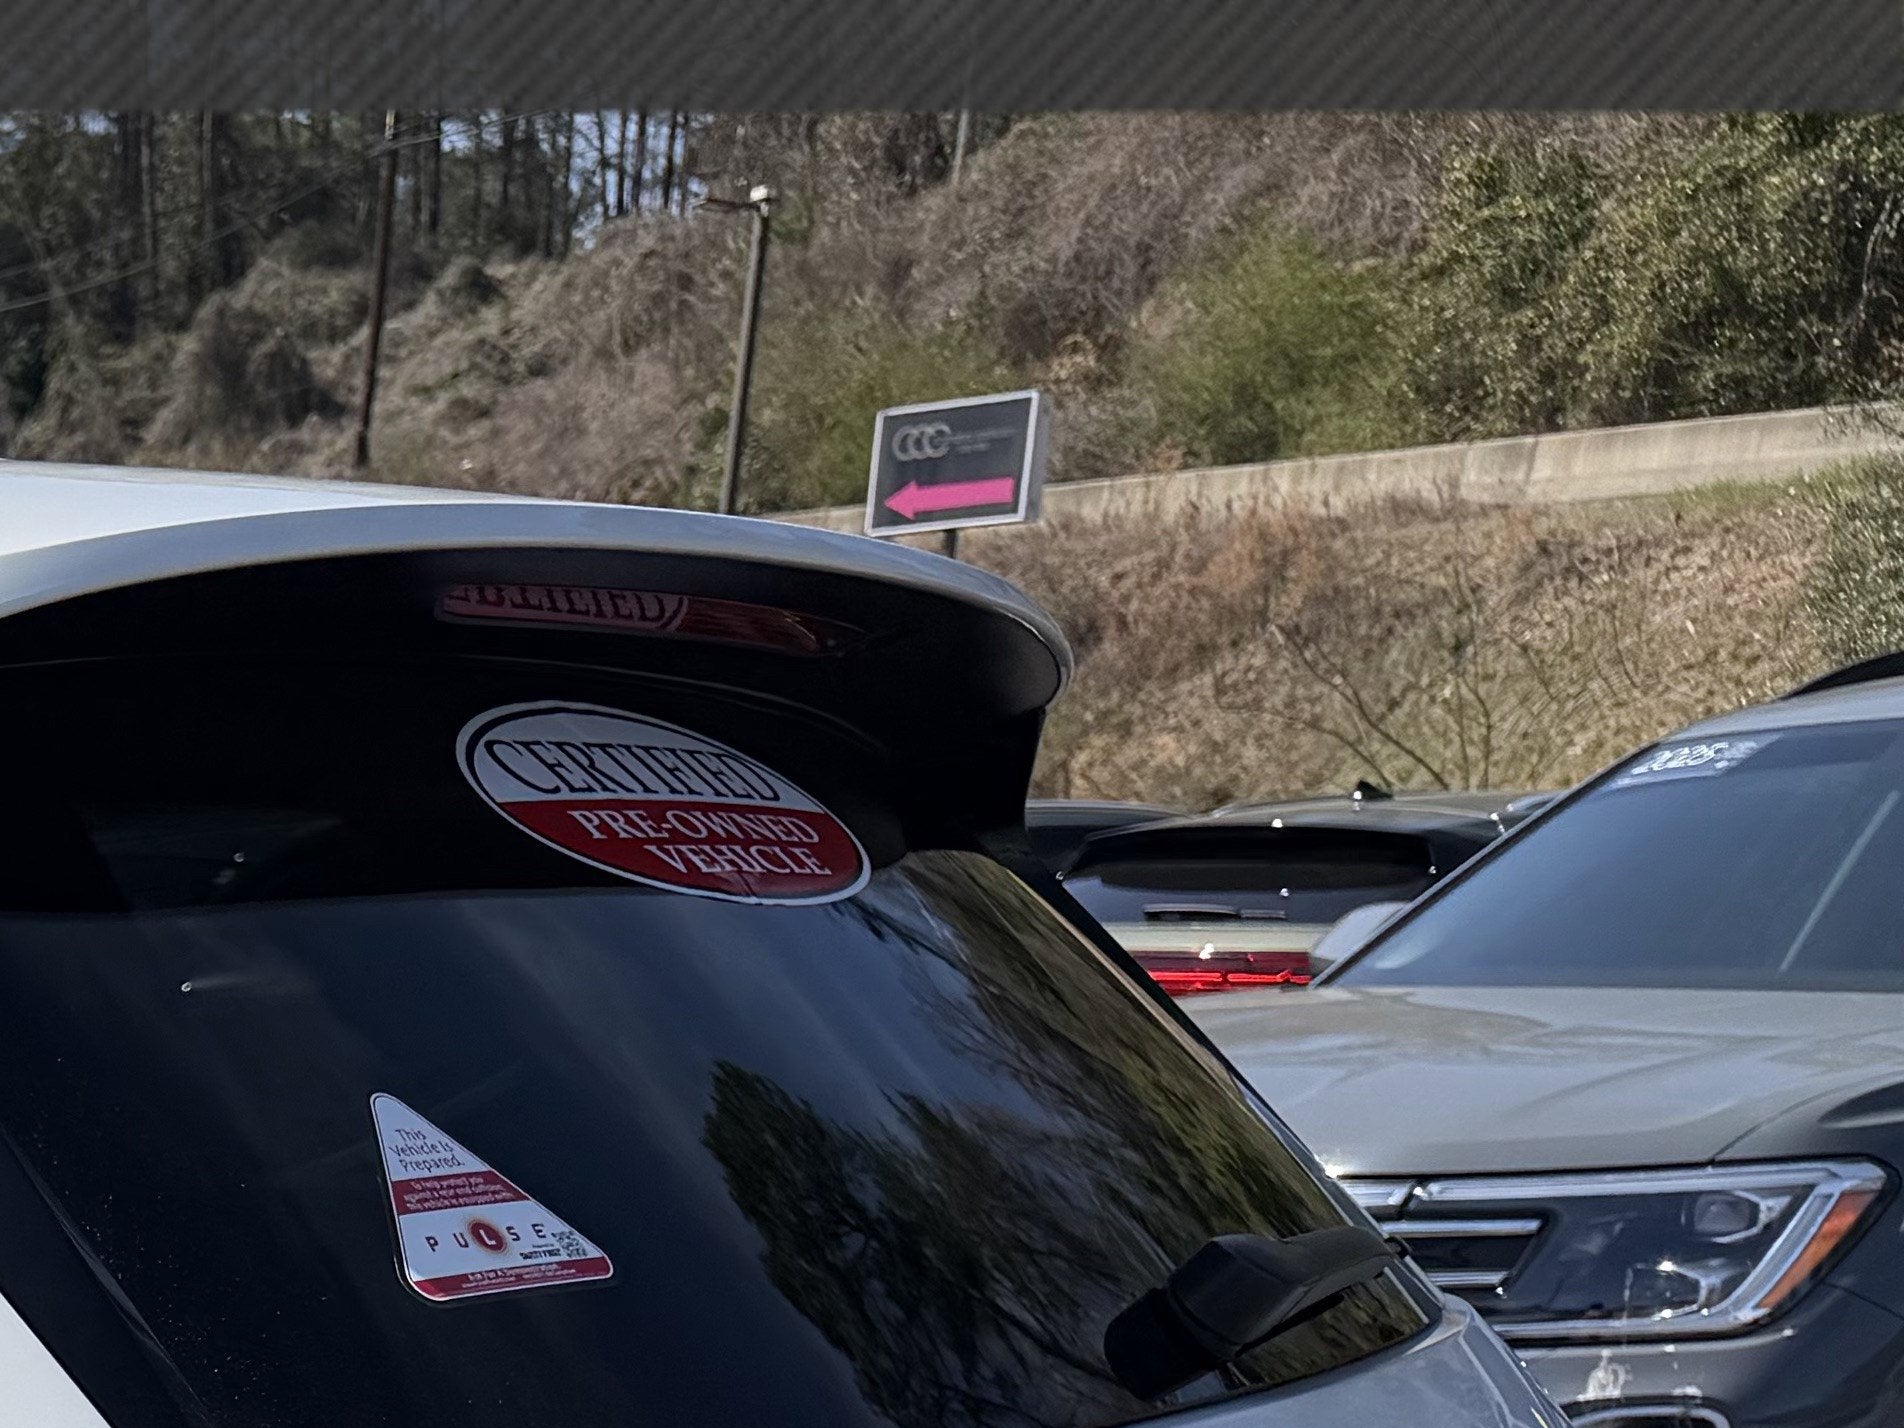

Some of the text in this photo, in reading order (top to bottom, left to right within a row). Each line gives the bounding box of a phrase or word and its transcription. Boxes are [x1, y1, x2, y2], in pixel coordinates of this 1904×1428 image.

[483, 739, 781, 802] CERTIFIED
[568, 809, 820, 844] PRE-OWNED
[643, 843, 832, 877] VEHICLE
[388, 1140, 440, 1157] Vehicle
[394, 1128, 427, 1141] This
